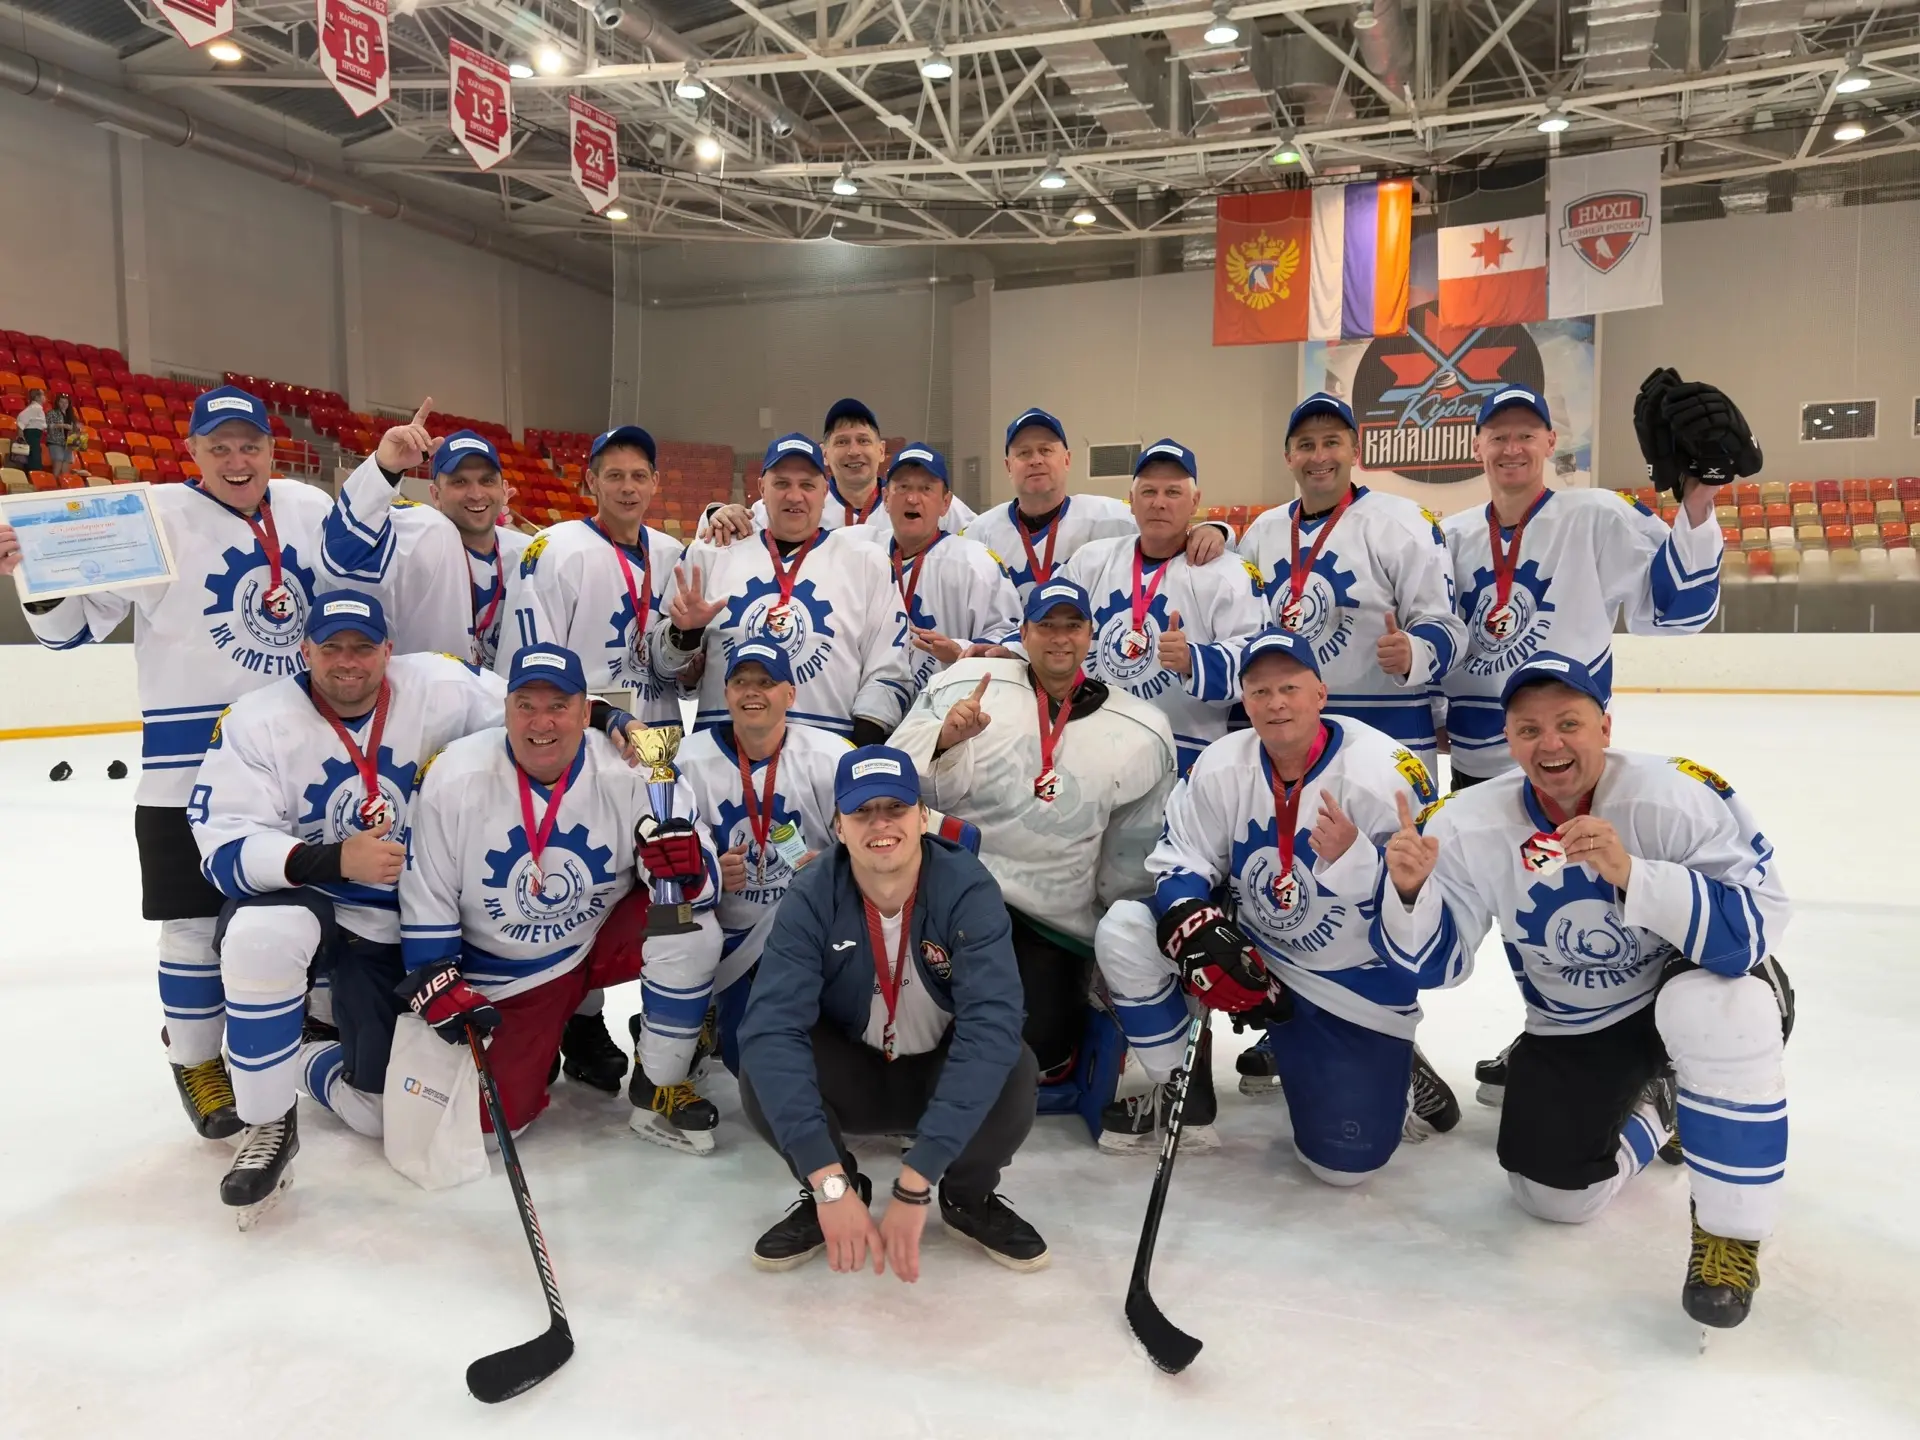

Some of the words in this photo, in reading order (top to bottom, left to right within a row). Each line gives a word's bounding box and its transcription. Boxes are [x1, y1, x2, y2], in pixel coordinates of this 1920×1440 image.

[344, 28, 369, 64] 19
[472, 92, 494, 125] 13
[585, 143, 604, 172] 24
[1578, 201, 1632, 224] НМХЛ
[278, 602, 287, 612] 1
[778, 617, 787, 626] 1
[1289, 616, 1298, 627] 1
[515, 607, 538, 647] 11
[1318, 615, 1355, 665] ЛУРГ»
[1498, 621, 1507, 632] 1
[209, 622, 235, 649] ХК
[231, 647, 307, 676] «МЕТАЛ
[796, 641, 833, 685] ЛУРГ»
[1463, 619, 1551, 676] МЕТАЛЛУРГ»
[1047, 784, 1056, 795] 1
[484, 897, 506, 920] ХК
[1284, 891, 1292, 902] 1
[1164, 906, 1226, 960] CCM
[410, 967, 461, 1015] AUER
[522, 1191, 567, 1320] WARRIOR
